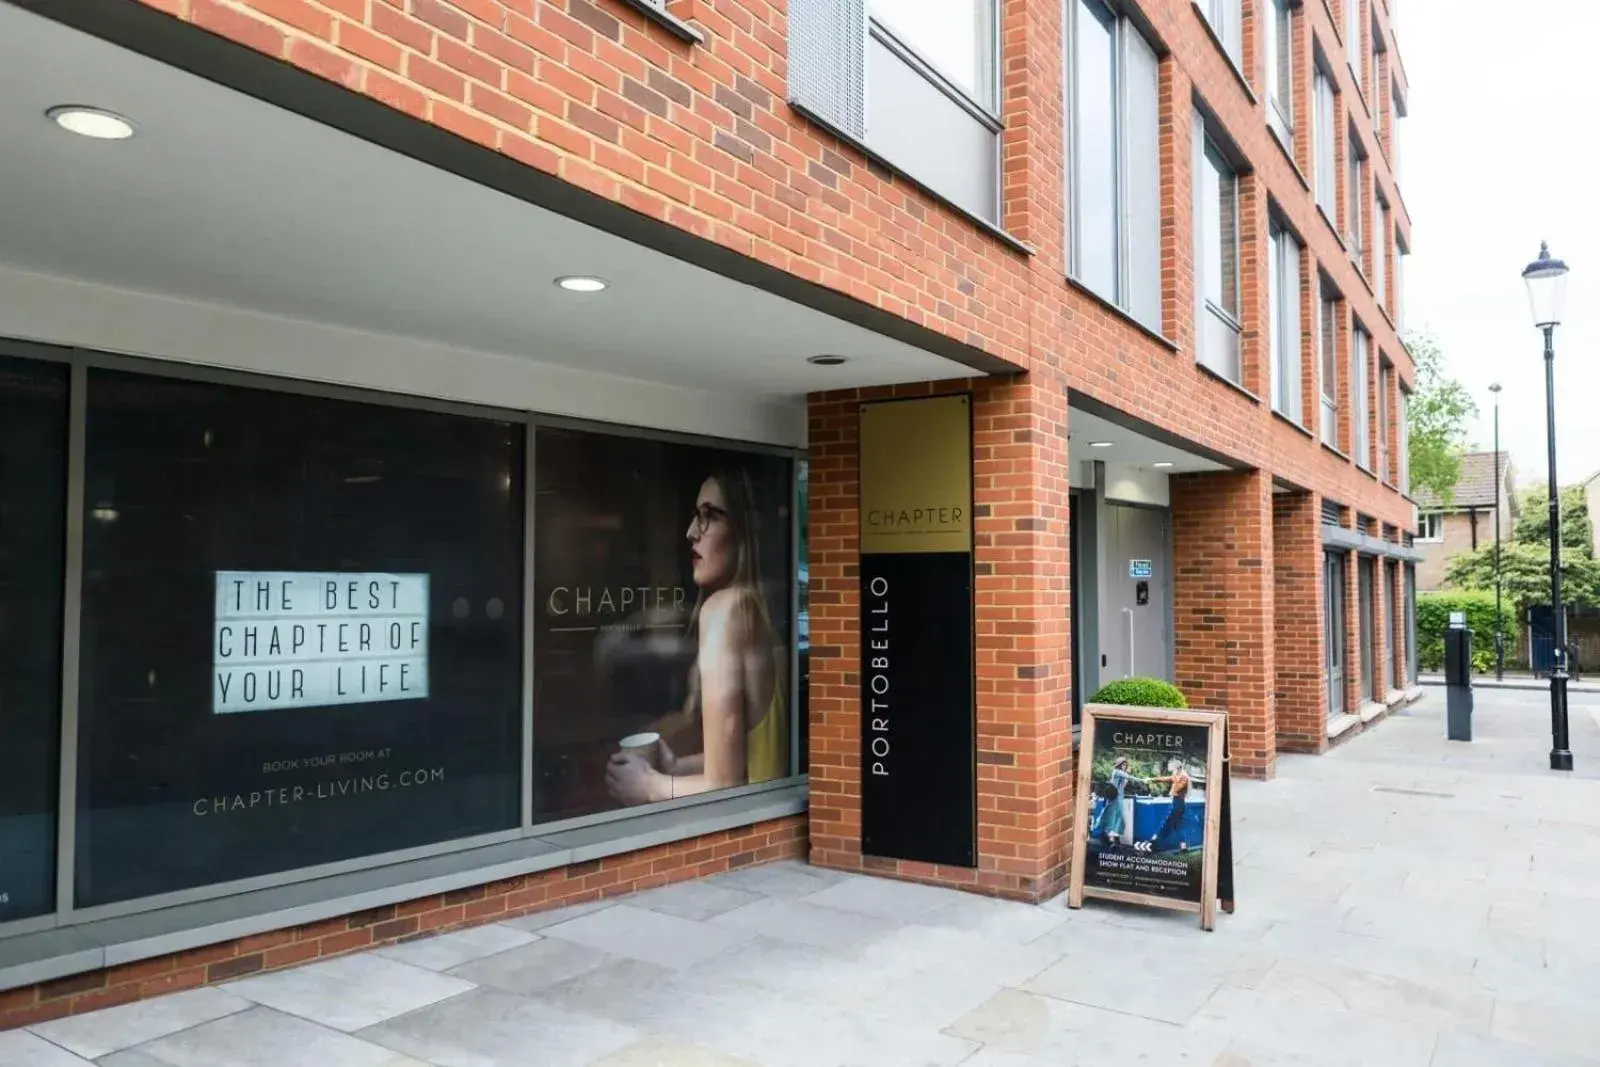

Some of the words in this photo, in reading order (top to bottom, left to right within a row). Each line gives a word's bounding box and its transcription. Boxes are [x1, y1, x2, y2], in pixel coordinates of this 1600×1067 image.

[868, 507, 963, 526] CHAPTER
[234, 580, 293, 611] THE
[326, 581, 399, 610] BEST
[550, 586, 685, 615] CHAPTER
[219, 623, 371, 657] CHAPTER
[390, 622, 420, 649] OF
[218, 669, 304, 703] YOUR
[337, 663, 410, 695] LIFE
[870, 577, 890, 775] PORTOBELLO
[1112, 732, 1183, 747] CHAPTER
[262, 760, 299, 774] BOOK
[303, 754, 336, 768] YOUR
[339, 750, 375, 763] ROOM
[378, 748, 392, 759] AT
[193, 767, 445, 816] CHAPTER-LIVING.COM
[1098, 852, 1125, 861] STUDENT
[1126, 856, 1188, 869] ACCOMMODATION
[1099, 860, 1118, 868] SHOW
[1151, 866, 1187, 876] RECEPTION
